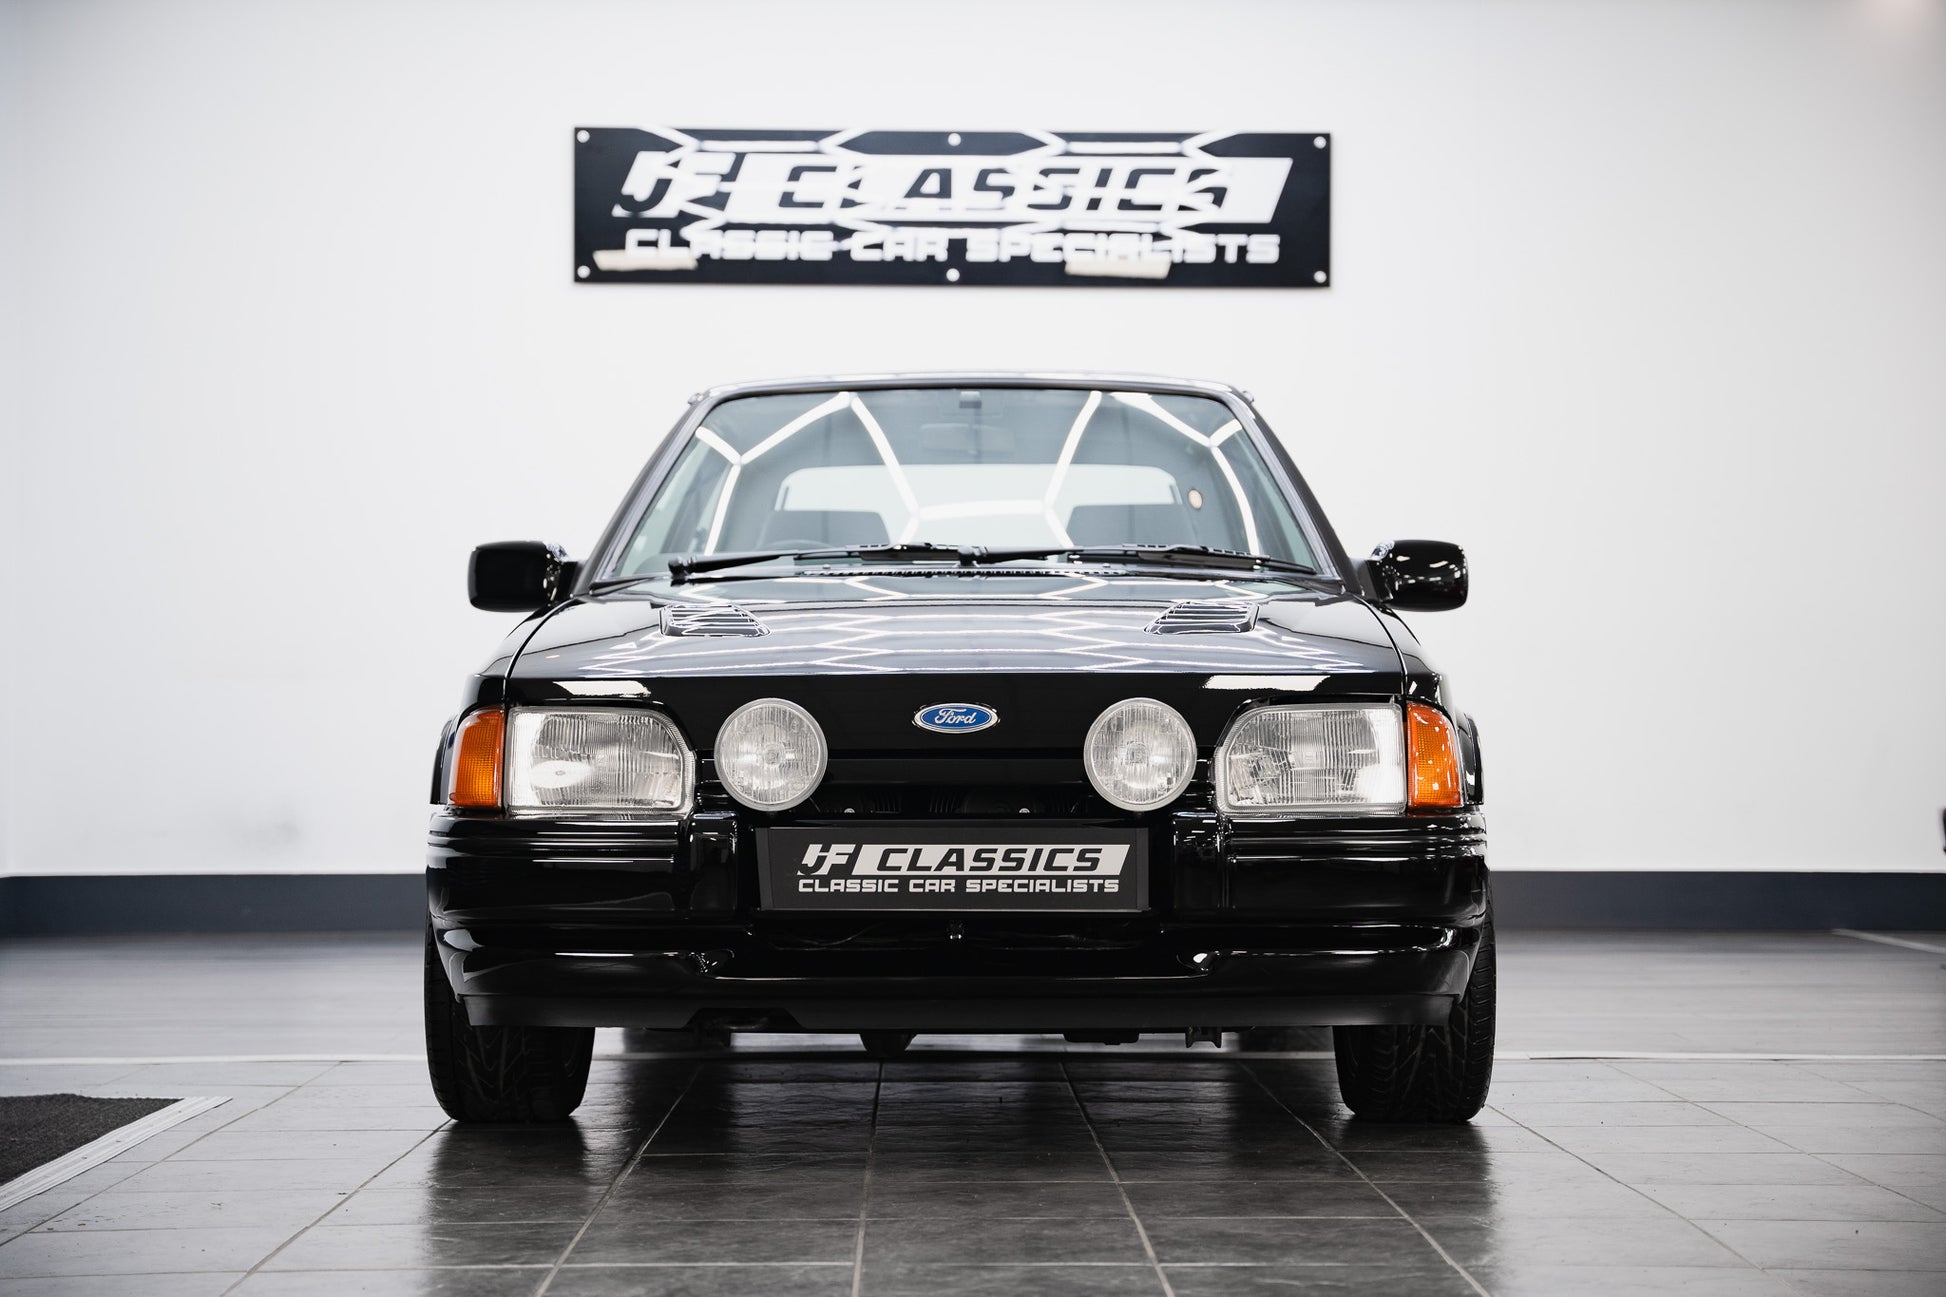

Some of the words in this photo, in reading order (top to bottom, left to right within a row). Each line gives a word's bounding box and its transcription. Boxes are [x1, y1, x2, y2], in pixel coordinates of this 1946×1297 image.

[849, 229, 949, 262] CAR
[934, 708, 977, 724] Ford
[797, 844, 856, 875] JF
[877, 848, 1102, 872] CLASSICS
[798, 879, 899, 892] CLASSIC
[909, 879, 956, 892] CAR
[965, 879, 1120, 892] SPECIALISTS
